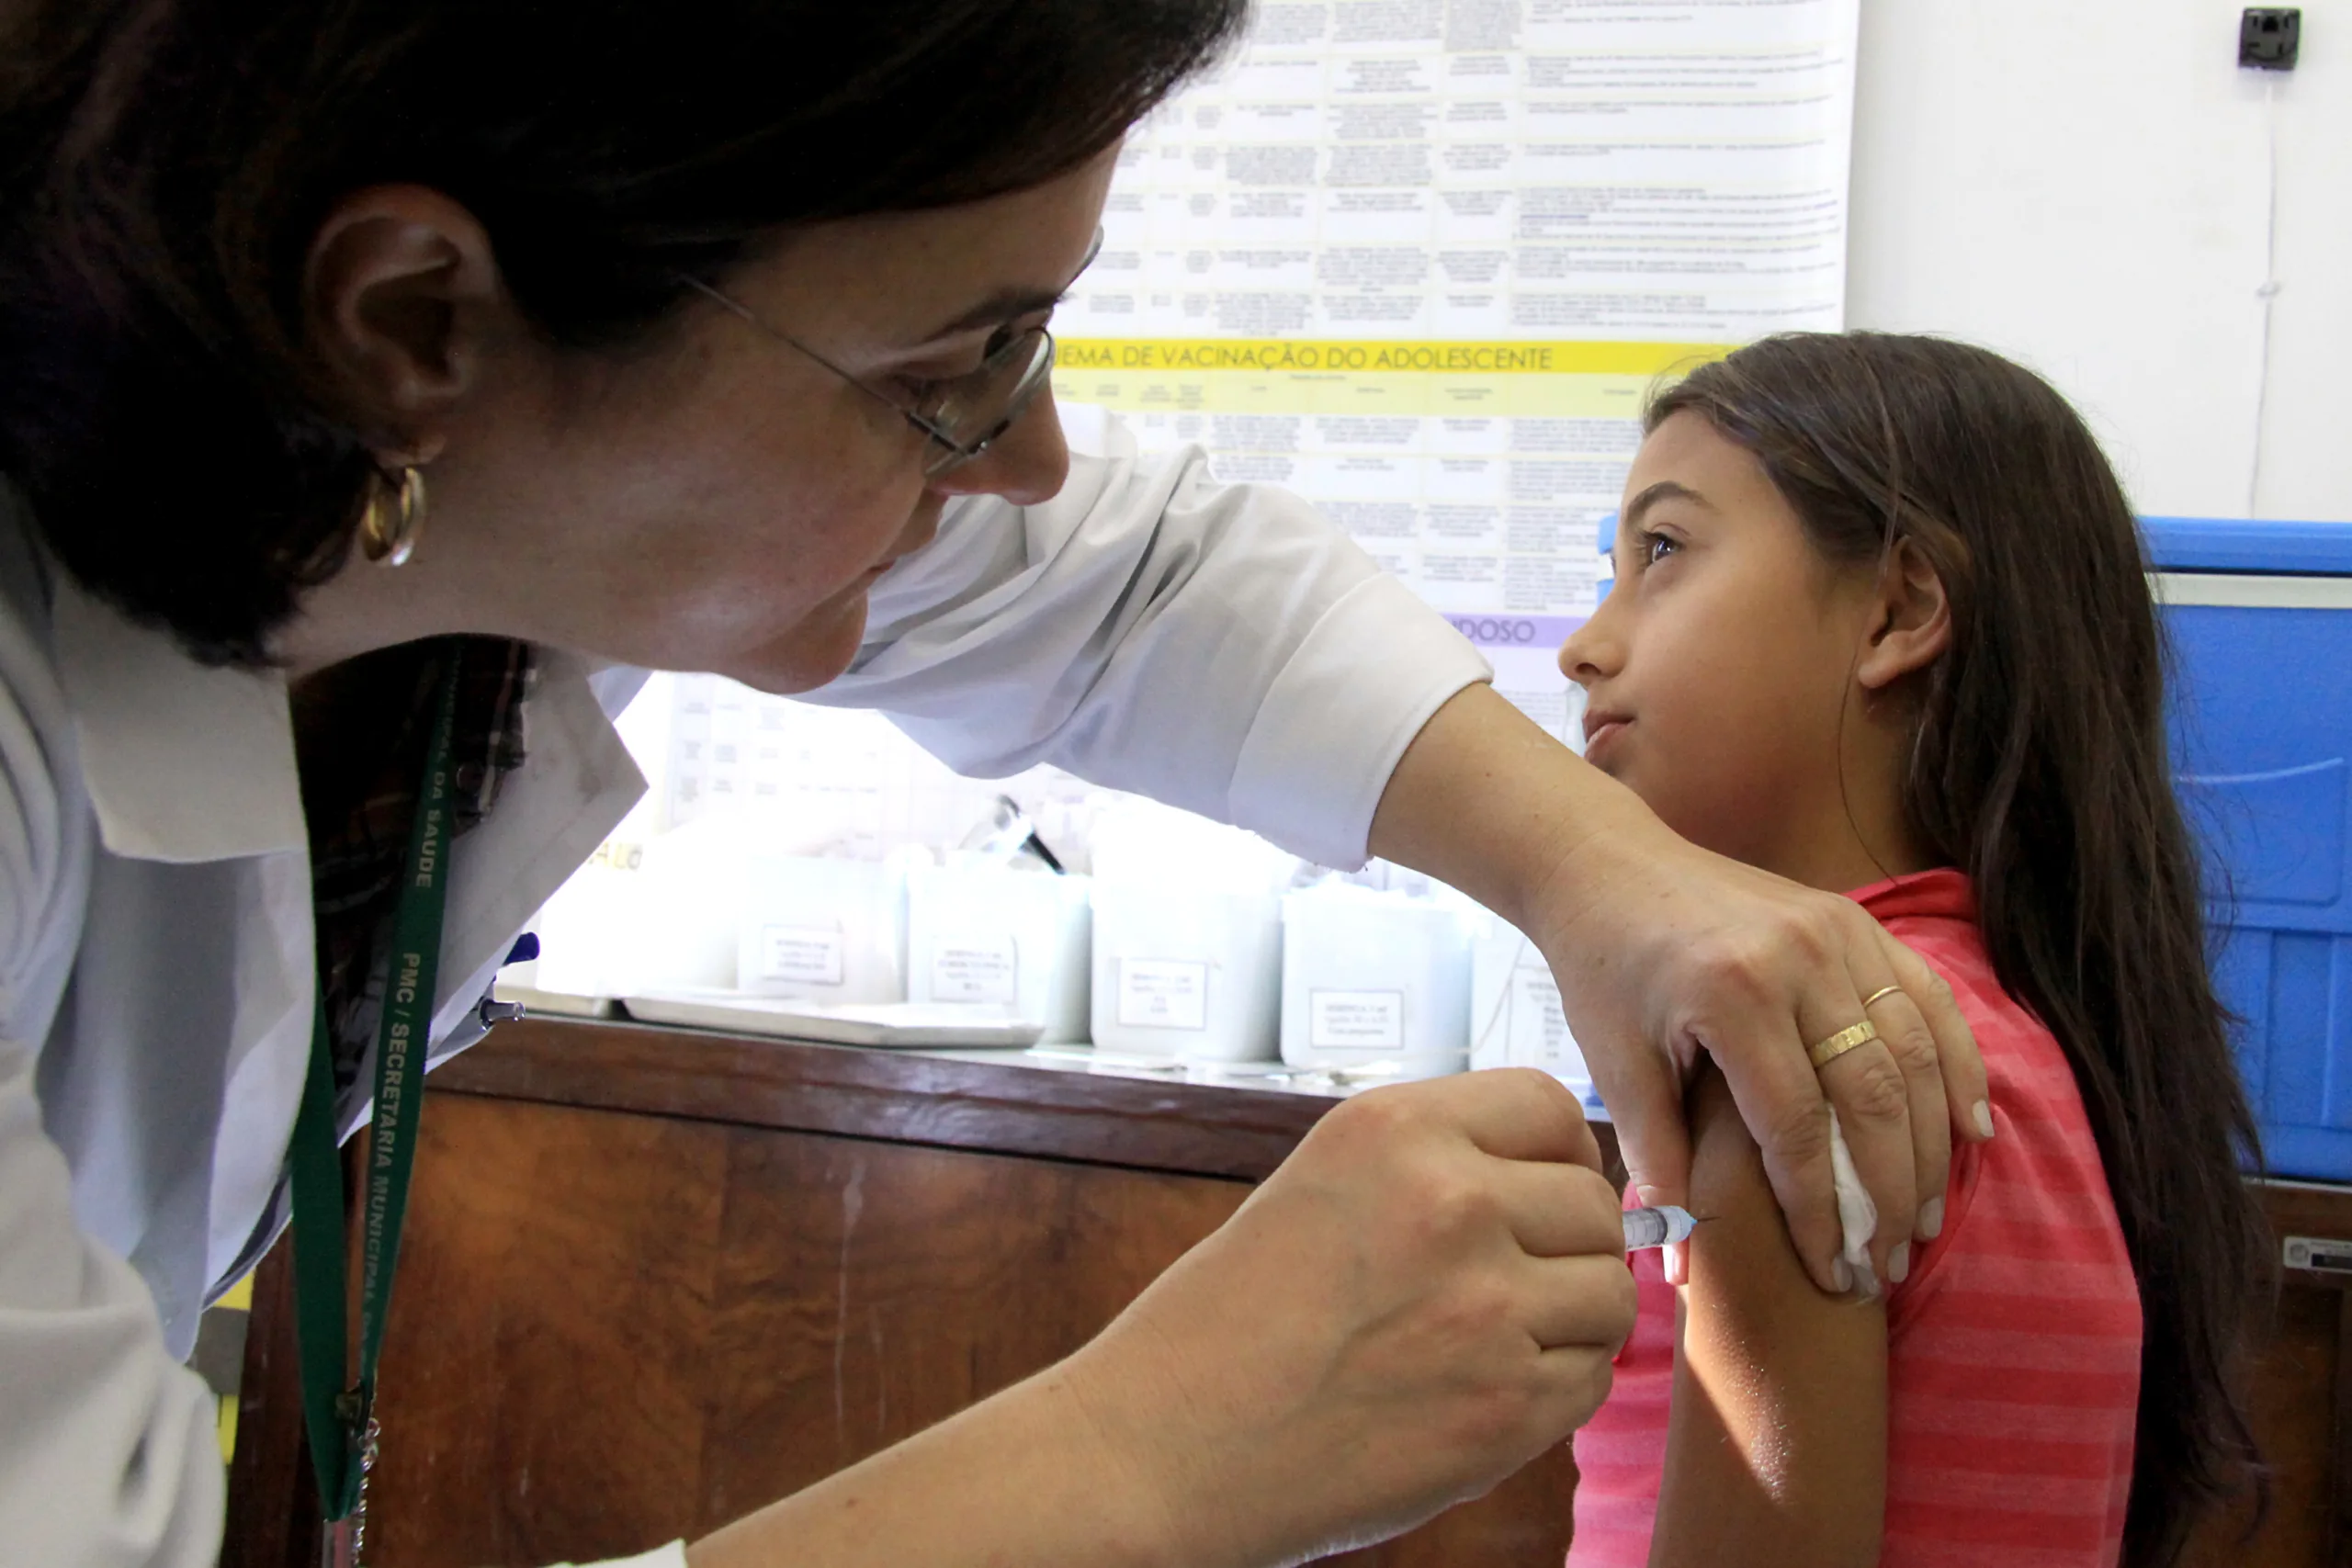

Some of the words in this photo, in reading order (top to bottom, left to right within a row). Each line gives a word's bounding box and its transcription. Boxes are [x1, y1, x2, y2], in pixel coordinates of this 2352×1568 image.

[1123, 345, 1155, 367] DE
[1161, 342, 1319, 372] VACINAÇÃO
[1327, 347, 1367, 369] DO
[1374, 347, 1553, 369] ADOLESCENTE
[432, 772, 446, 799] DA
[415, 809, 441, 887] SAUDE
[396, 953, 421, 1003] PMC
[375, 1022, 410, 1168] SECRETARIA
[365, 1176, 390, 1301] MUNICIPAL
